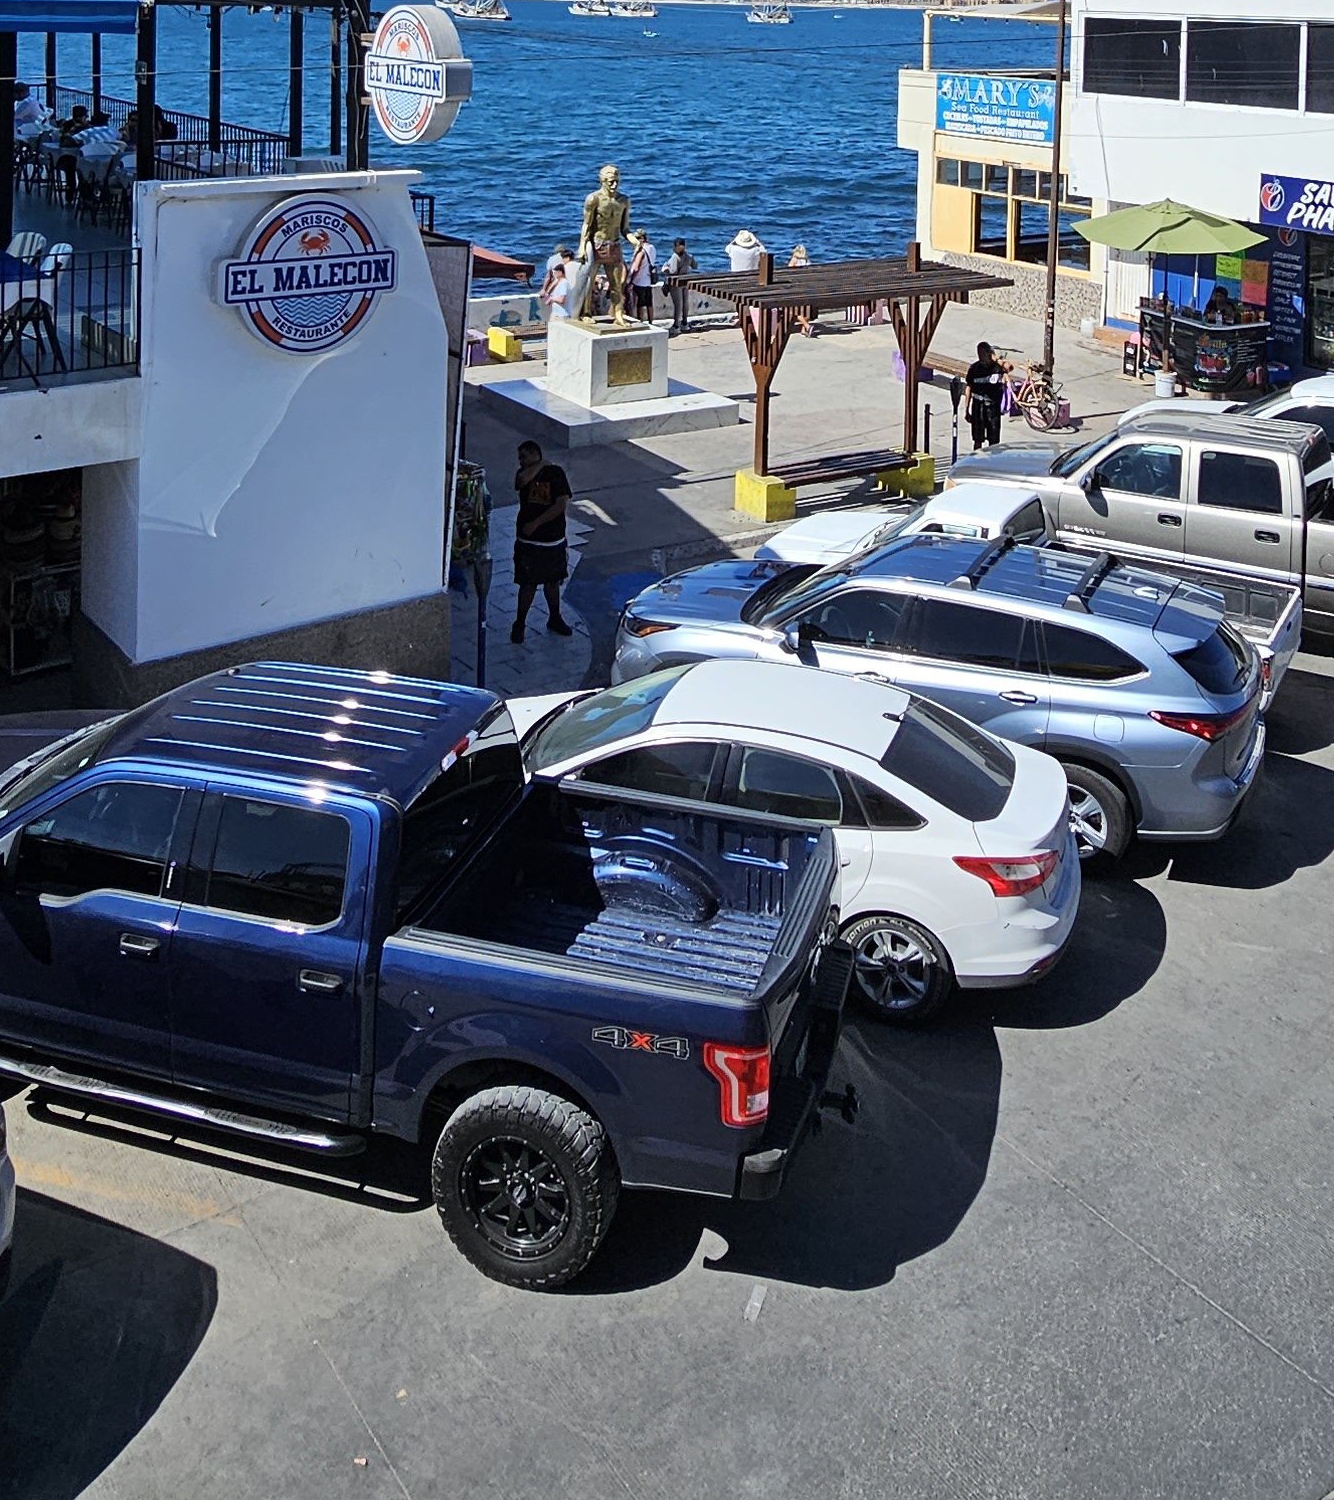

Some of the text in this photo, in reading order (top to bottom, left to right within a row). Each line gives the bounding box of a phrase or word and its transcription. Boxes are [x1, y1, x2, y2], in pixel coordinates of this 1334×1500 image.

[388, 21, 420, 41] MARISCOS
[369, 60, 441, 92] EL MALECON
[951, 76, 1041, 109] MARY'S
[951, 101, 1040, 120] Sea Food Restaurant
[280, 214, 349, 238] MARISCOS
[230, 257, 391, 296] EL MALECON
[271, 309, 352, 339] RESTAURANTE
